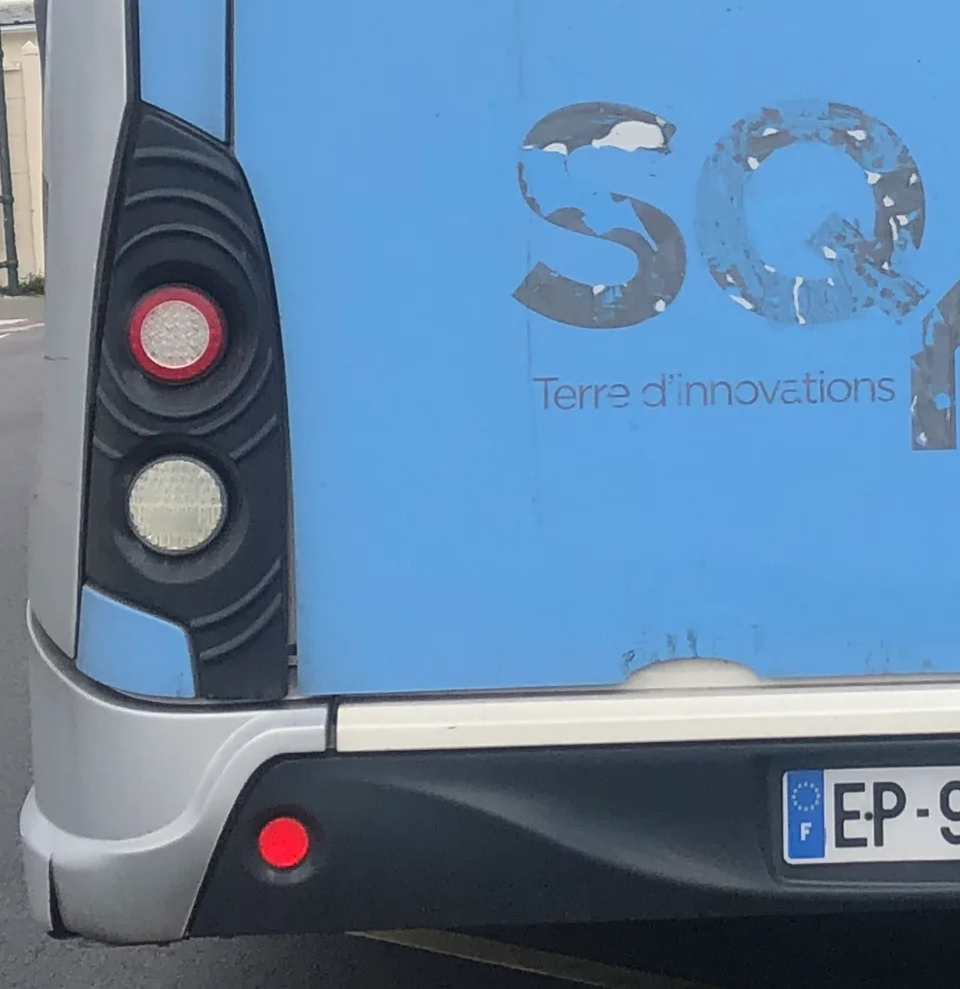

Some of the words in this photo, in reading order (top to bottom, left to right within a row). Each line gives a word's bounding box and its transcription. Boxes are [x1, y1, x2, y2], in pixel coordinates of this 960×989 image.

[533, 376, 631, 410] Terre
[641, 369, 896, 408] d'innovations
[800, 821, 812, 841] F
